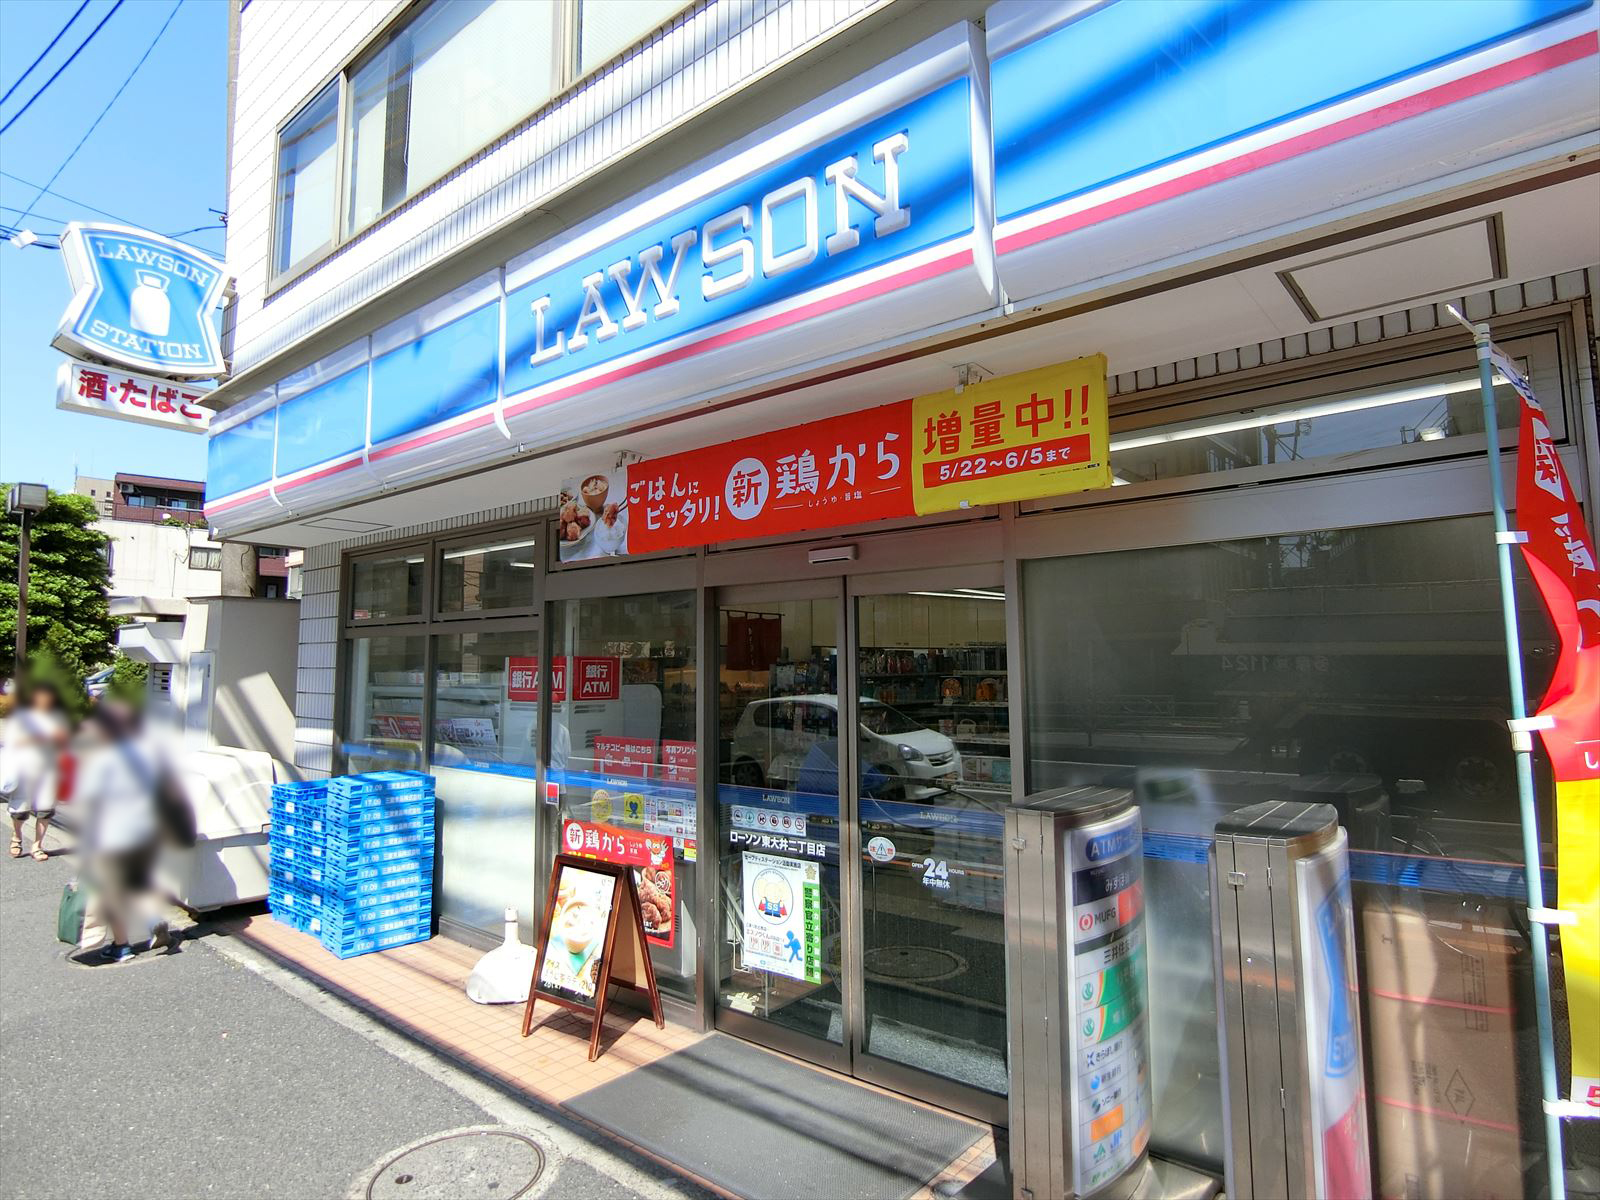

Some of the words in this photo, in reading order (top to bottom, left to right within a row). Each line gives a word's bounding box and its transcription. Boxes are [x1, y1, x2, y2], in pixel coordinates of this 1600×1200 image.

[96, 241, 209, 287] LAWSON
[531, 130, 911, 367] LAWSON
[90, 319, 203, 359] STATION
[78, 369, 203, 419] 酒・たばこ
[630, 472, 699, 504] ごはんに
[732, 469, 762, 508] 新
[776, 432, 900, 499] 鶏から
[583, 681, 610, 693] ATM
[585, 664, 608, 679] 銀行
[923, 857, 949, 880] 24
[1094, 906, 1117, 926] MUFG
